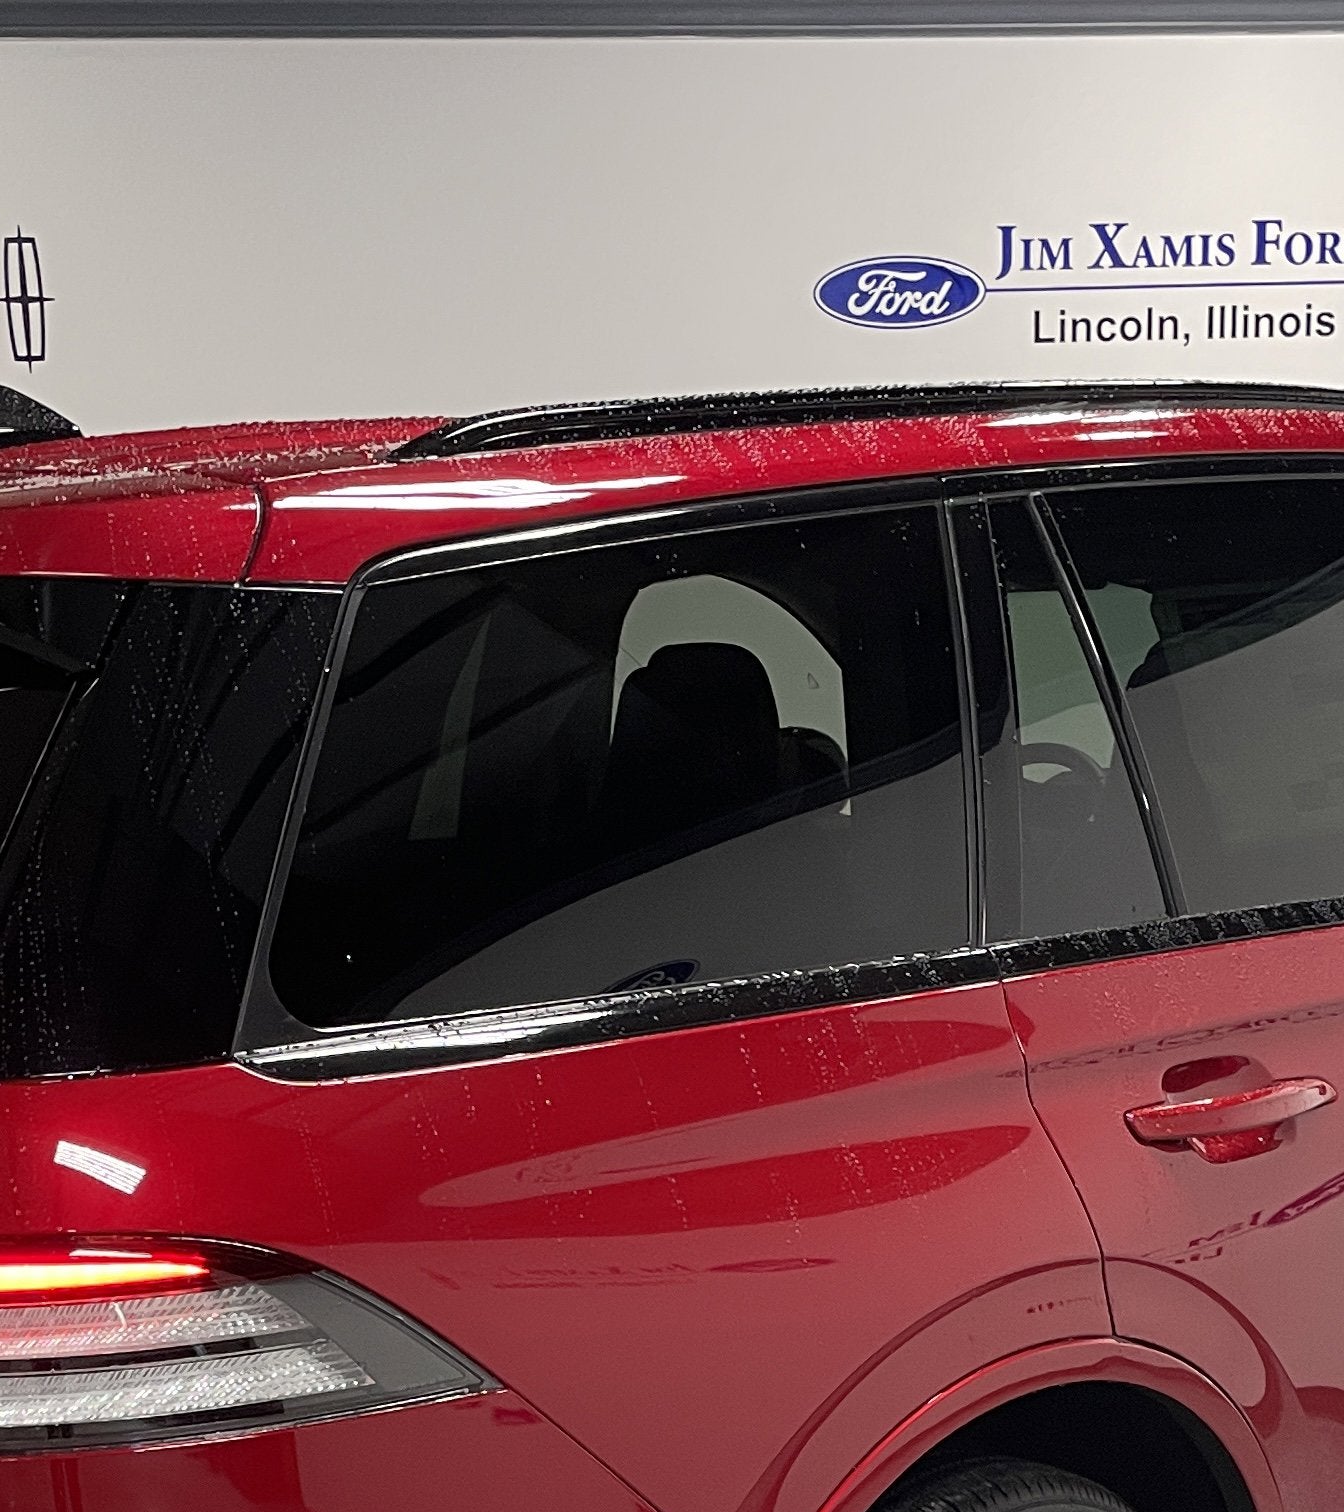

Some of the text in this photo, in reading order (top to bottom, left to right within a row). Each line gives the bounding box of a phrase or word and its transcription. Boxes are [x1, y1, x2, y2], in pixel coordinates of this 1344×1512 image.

[994, 225, 1073, 281] JIM
[1086, 222, 1236, 270] XAMIS
[847, 268, 951, 318] Ford
[1034, 303, 1335, 347] Lincoln, Illinois
